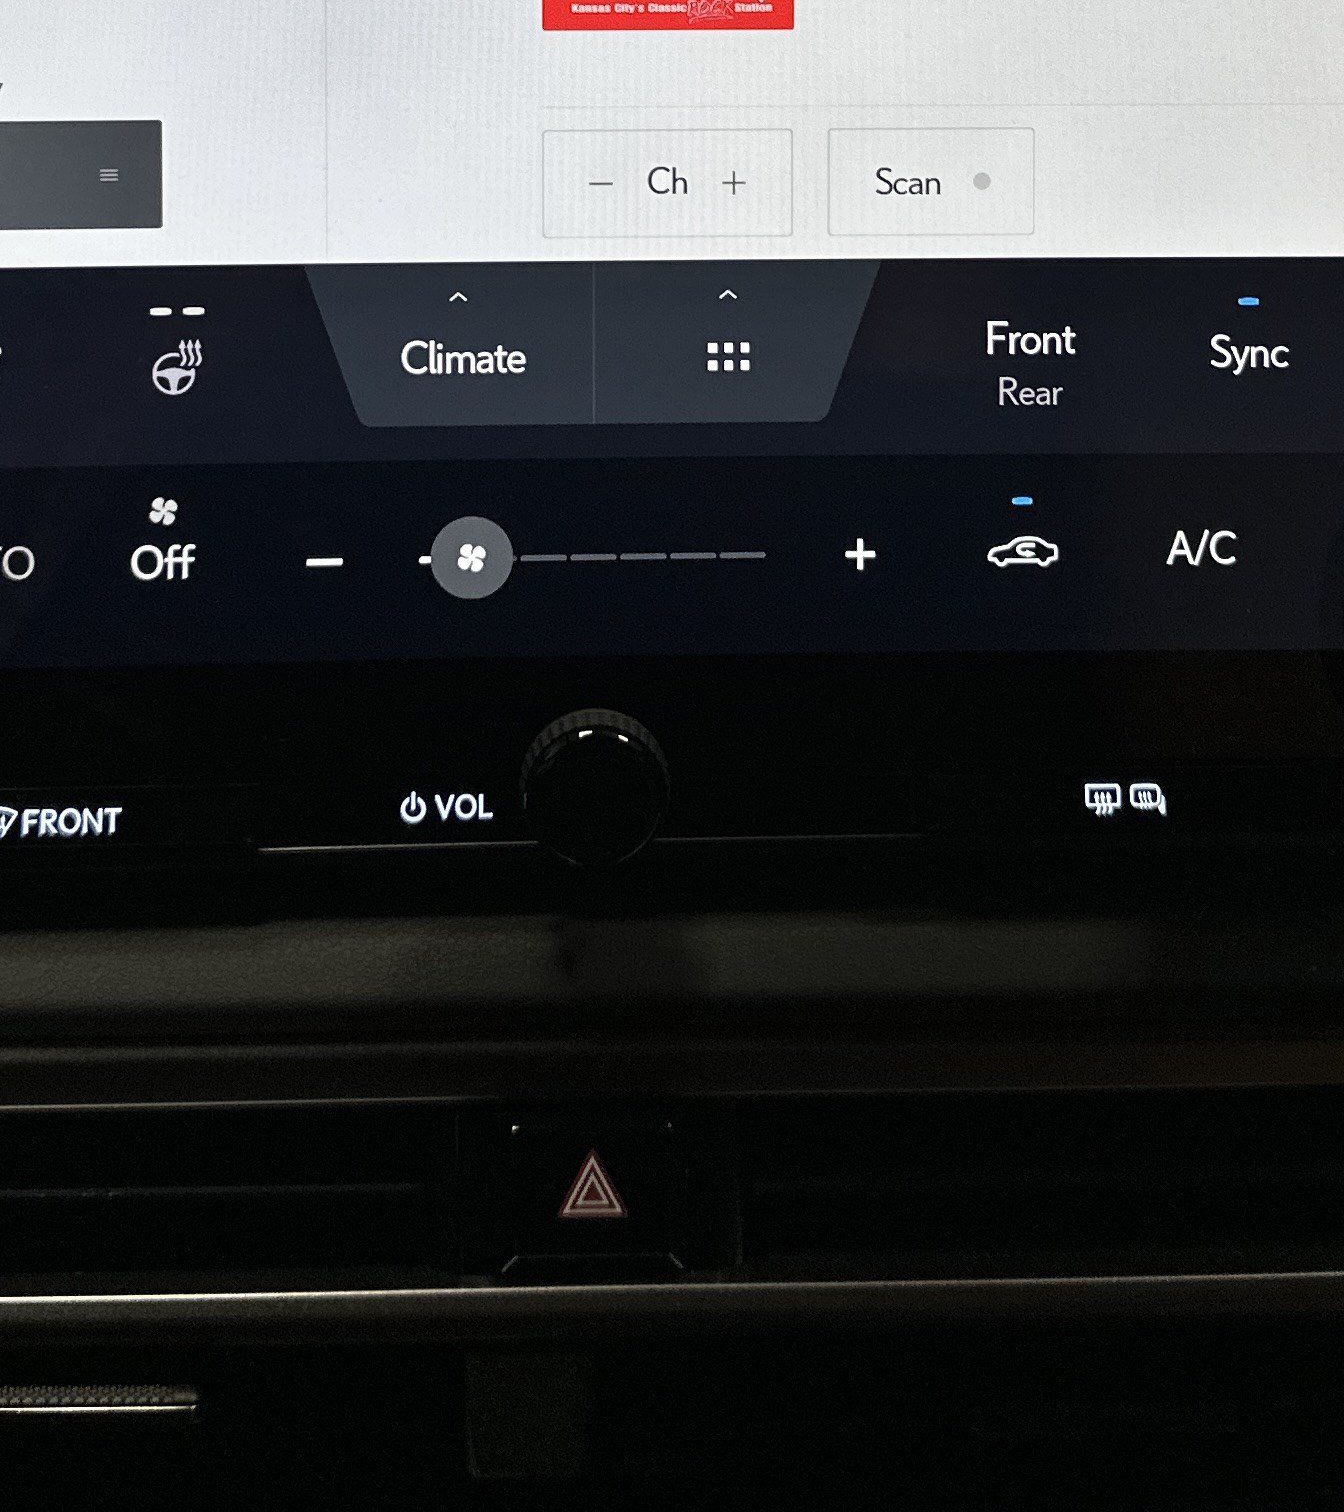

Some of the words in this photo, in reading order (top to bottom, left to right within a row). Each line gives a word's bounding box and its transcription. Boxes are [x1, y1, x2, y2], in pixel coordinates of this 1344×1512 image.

[570, 2, 612, 14] Kansas
[734, 2, 774, 13] Station
[647, 165, 689, 195] Ch
[875, 166, 942, 196] Scan
[986, 320, 1077, 356] Front
[400, 339, 527, 376] Climate
[1210, 333, 1290, 376] Sync
[998, 376, 1064, 406] Rear
[130, 543, 197, 581] Off
[1165, 528, 1237, 567] A/C
[20, 806, 123, 837] FRONT
[434, 792, 494, 821] VOL
